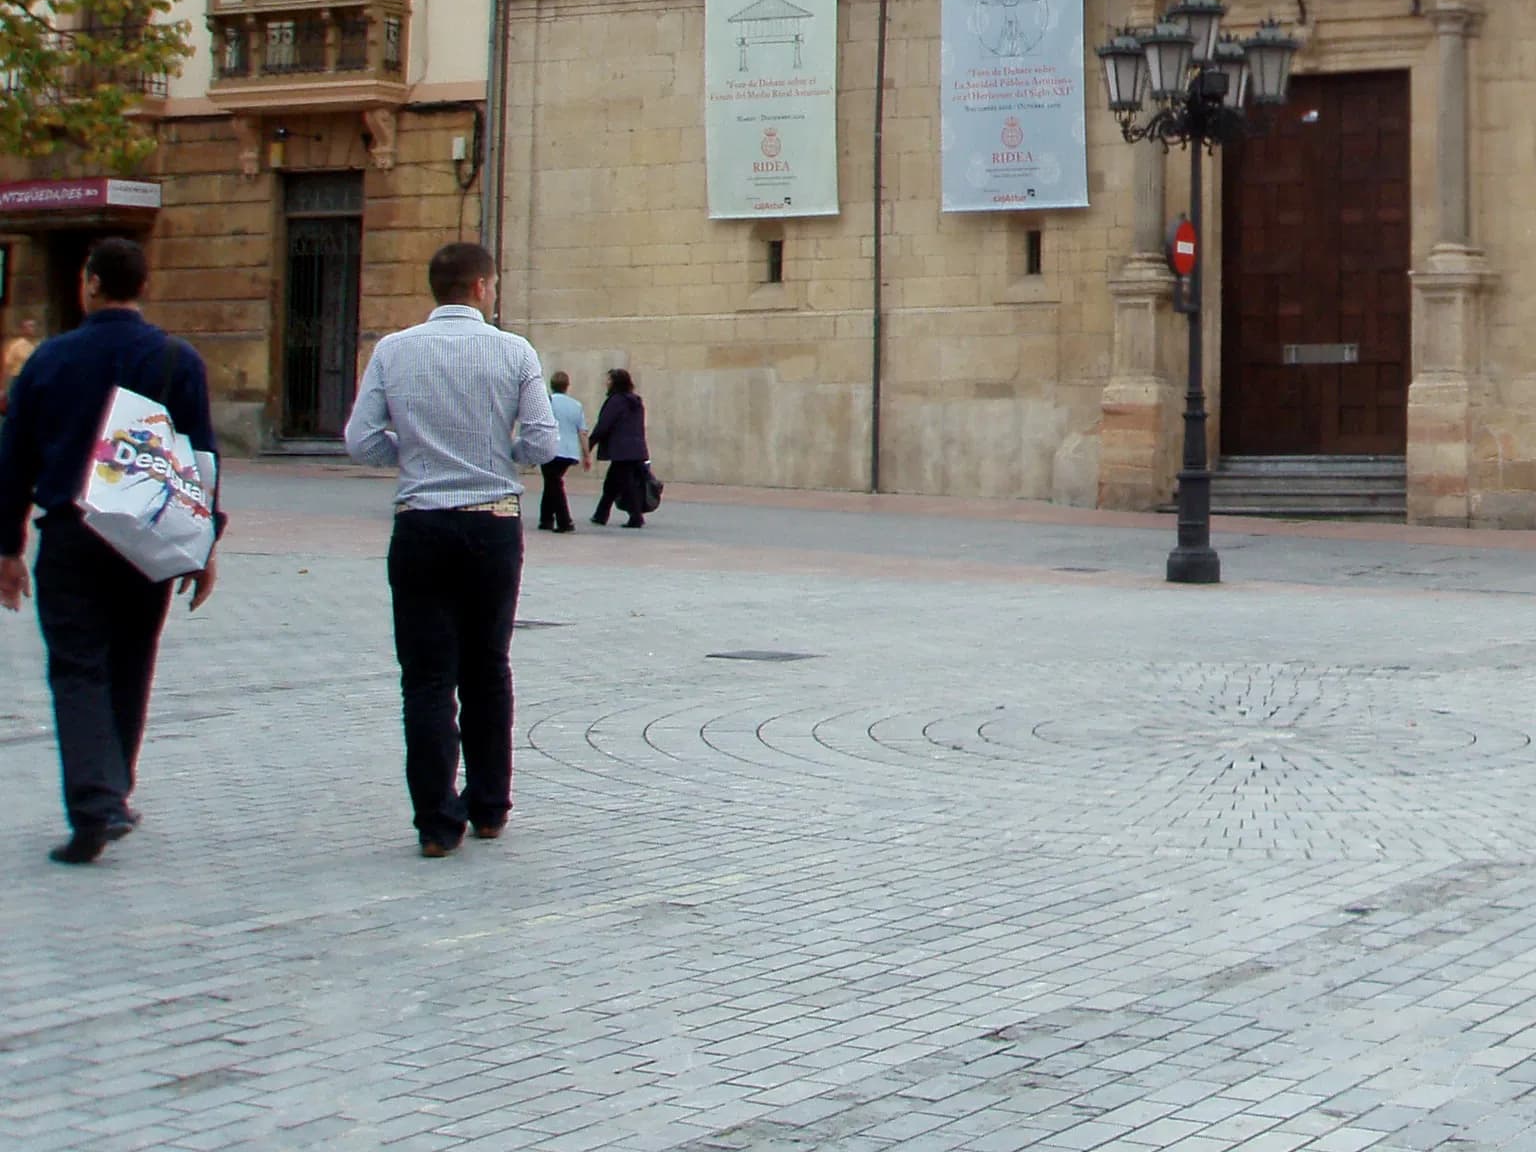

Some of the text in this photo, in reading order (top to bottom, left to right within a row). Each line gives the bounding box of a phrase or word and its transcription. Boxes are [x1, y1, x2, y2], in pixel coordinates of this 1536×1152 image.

[992, 151, 1033, 164] RIDEA
[753, 161, 790, 173] RIDEA
[0, 186, 82, 204] NTIGÜEDADES
